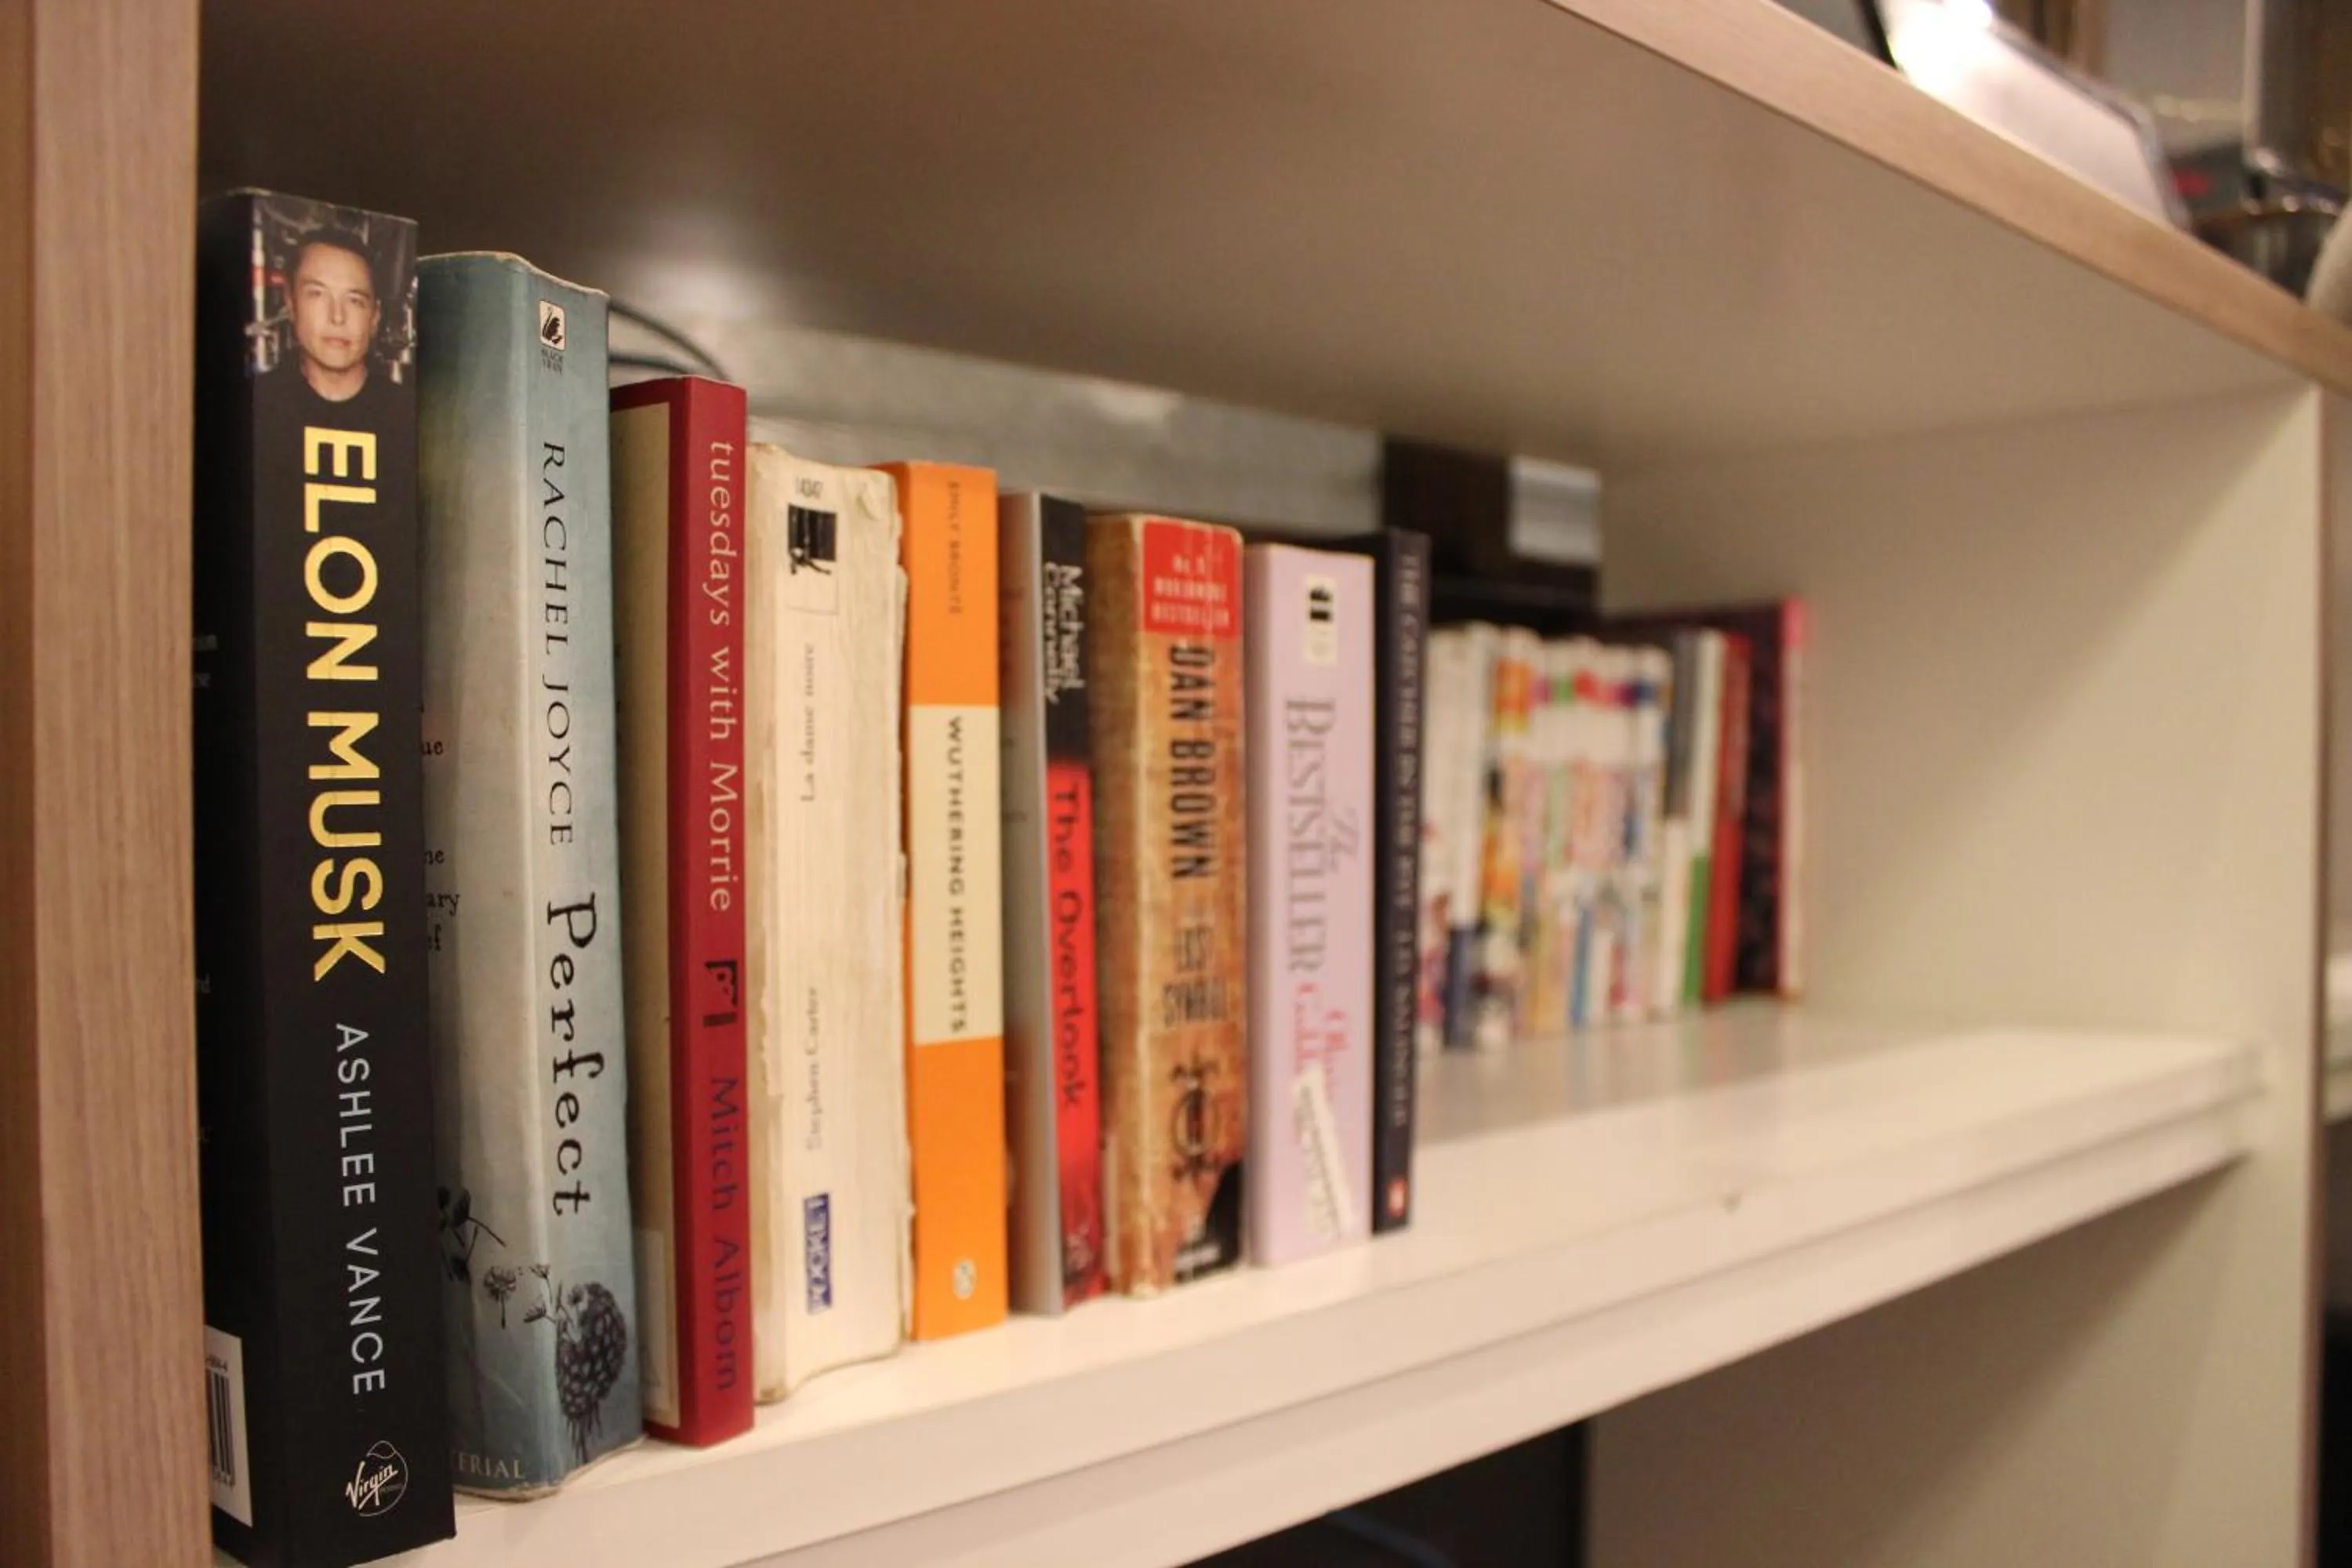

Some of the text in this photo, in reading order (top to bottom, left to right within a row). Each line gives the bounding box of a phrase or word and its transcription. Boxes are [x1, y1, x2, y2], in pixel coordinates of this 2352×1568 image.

[303, 426, 387, 983] ELON MUSK
[543, 441, 573, 845] RACHEL JOYCE
[702, 441, 739, 912] tuesdays with Morrie
[801, 643, 815, 803] La dame noire
[1169, 644, 1214, 720] DAN
[946, 716, 968, 1034] WUTHERING HEIGHTS
[1054, 781, 1080, 872] The
[1169, 740, 1215, 880] BROWN
[336, 1023, 386, 1395] ASHLEE VANCE
[547, 892, 604, 1217] Perfect
[804, 986, 823, 1152] Stephen Carter
[710, 1075, 739, 1391] Mitch Albom
[345, 1460, 398, 1512] Virgin
